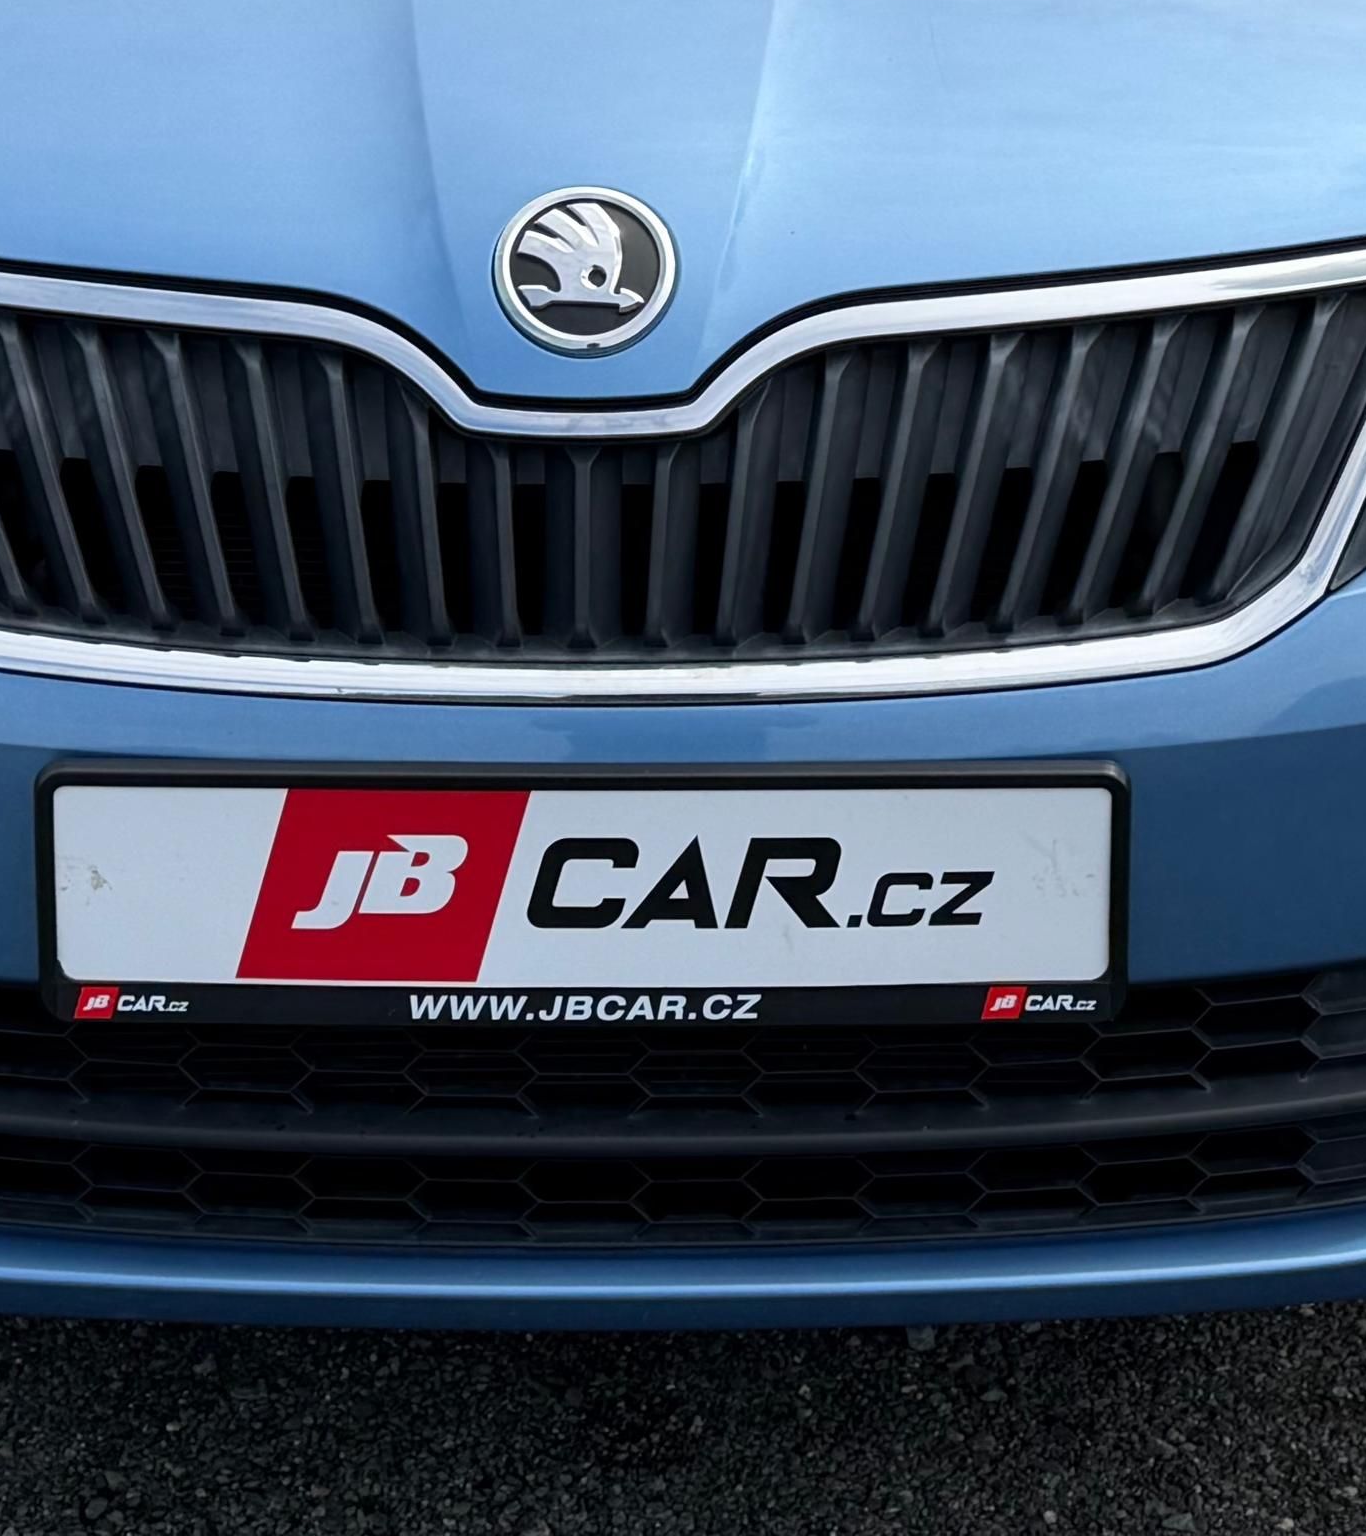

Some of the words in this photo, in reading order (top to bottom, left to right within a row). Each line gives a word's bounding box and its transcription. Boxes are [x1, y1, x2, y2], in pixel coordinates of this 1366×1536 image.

[291, 834, 469, 929] JB
[82, 994, 111, 1011] JB
[409, 994, 762, 1021] WWW.JBCAR.CZ
[989, 994, 1018, 1012] JB
